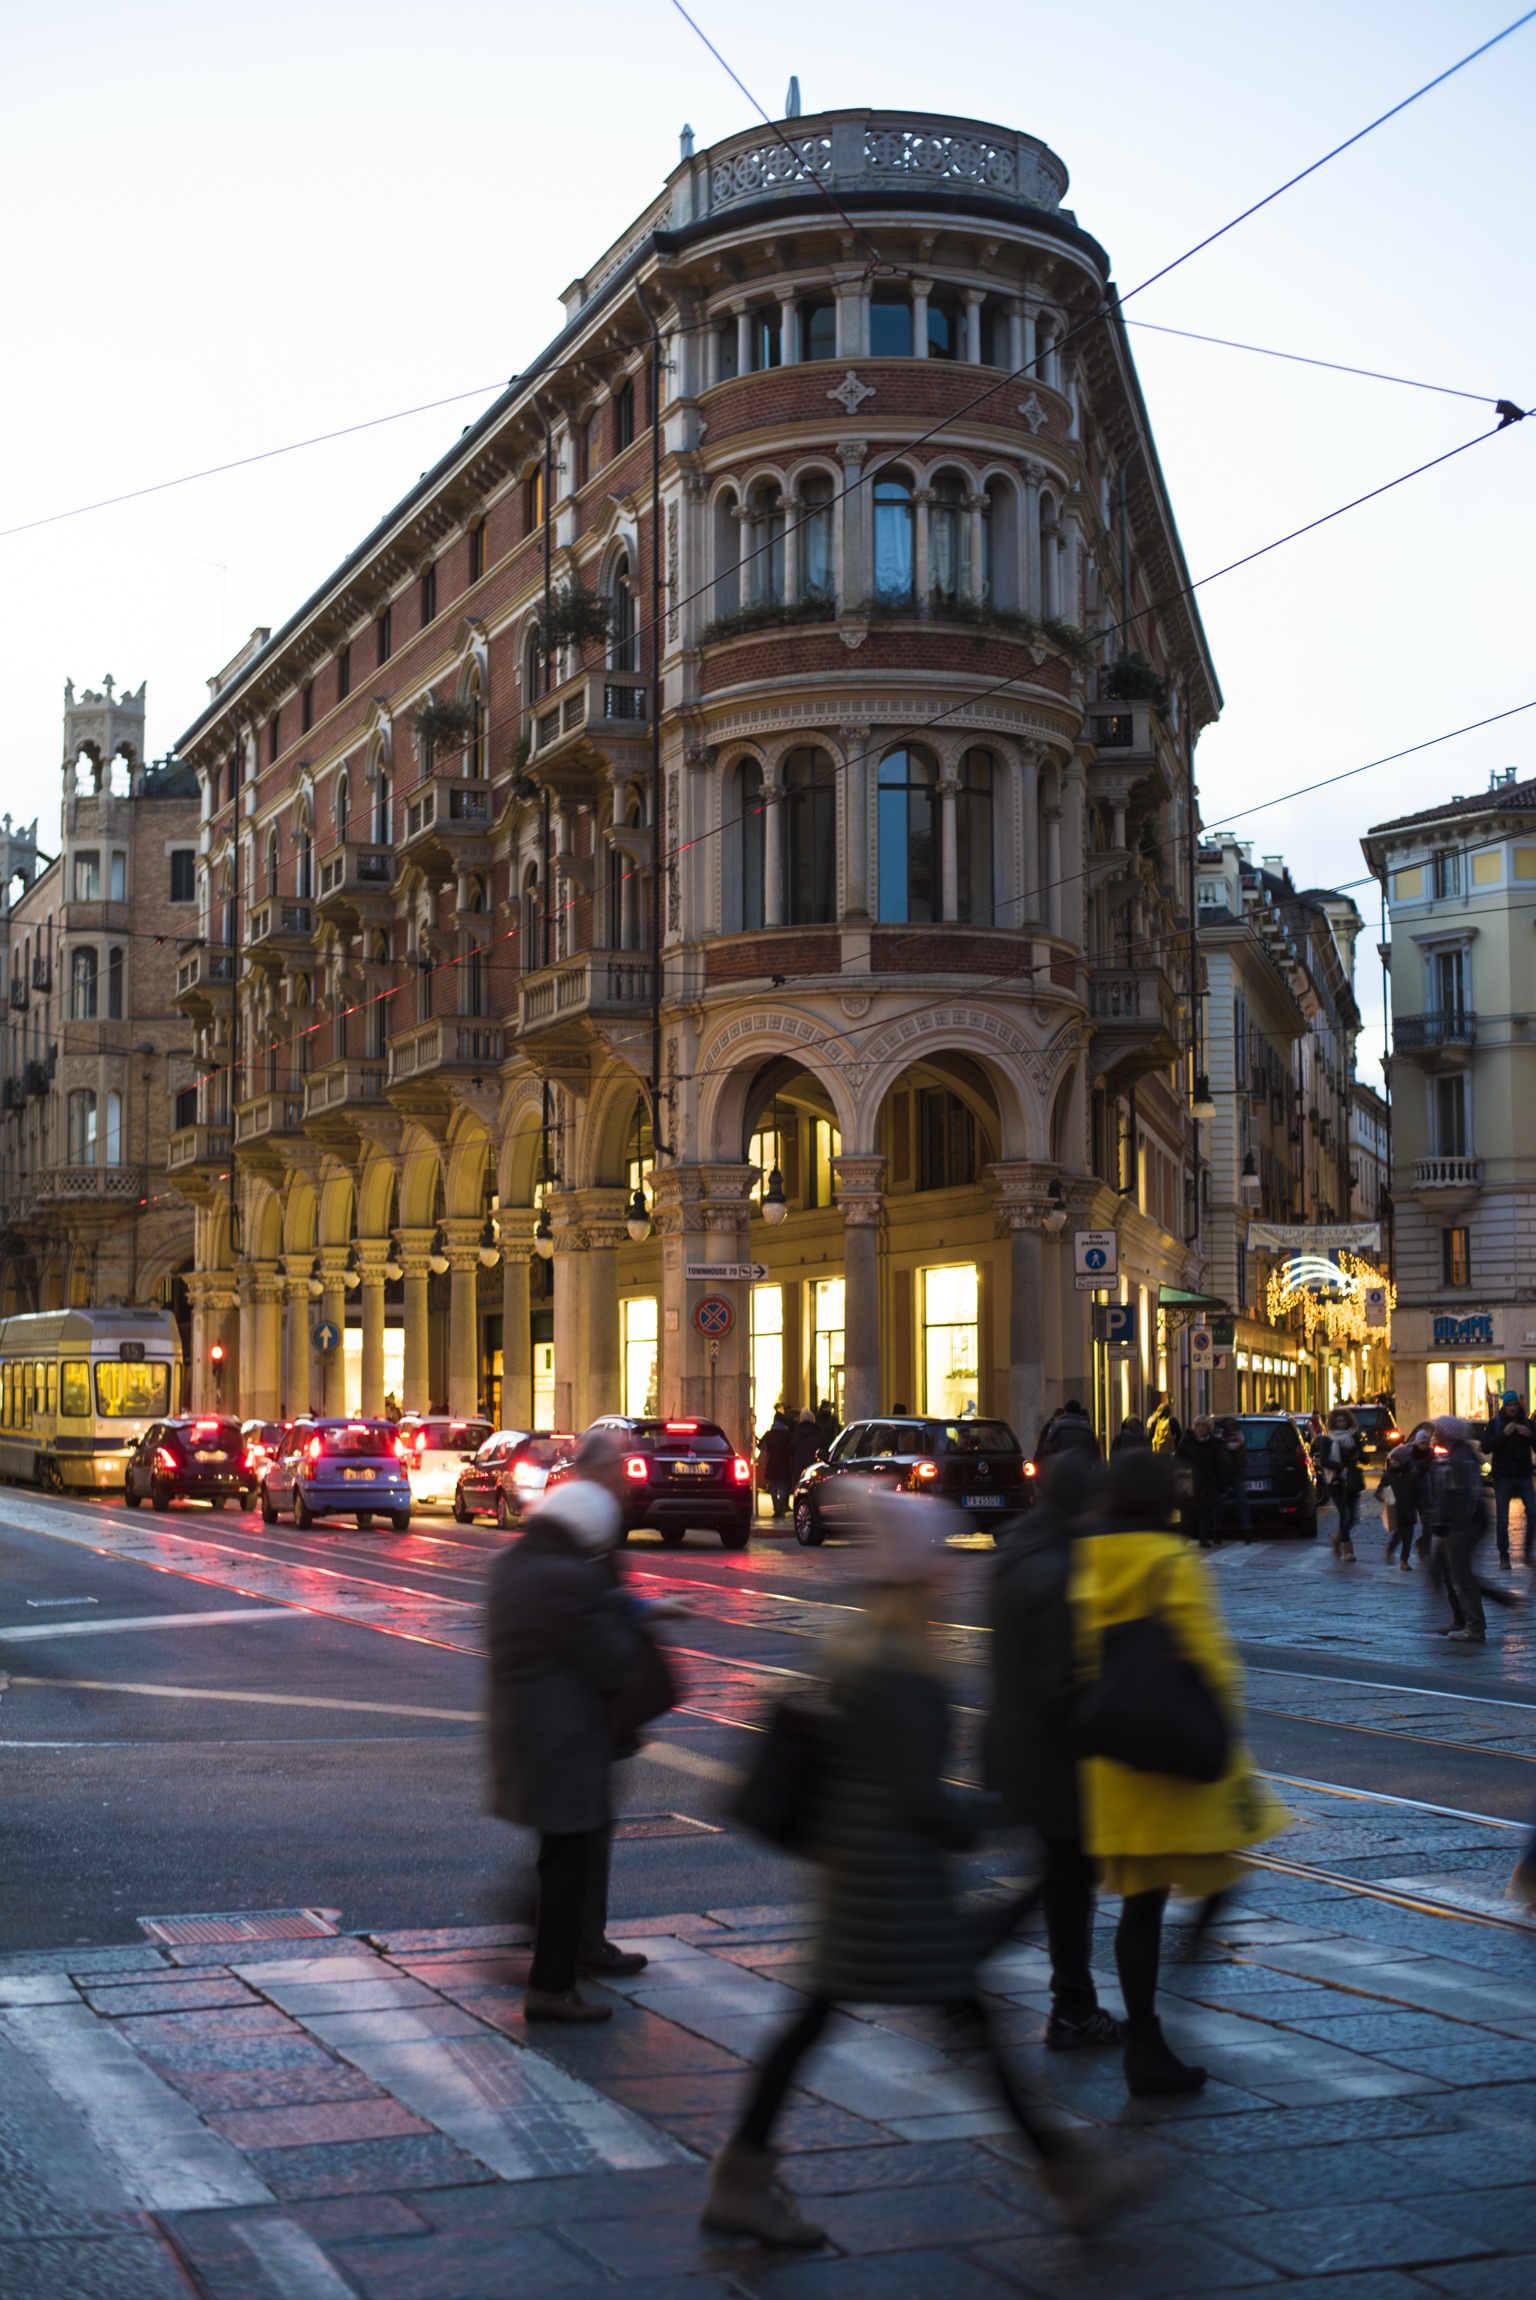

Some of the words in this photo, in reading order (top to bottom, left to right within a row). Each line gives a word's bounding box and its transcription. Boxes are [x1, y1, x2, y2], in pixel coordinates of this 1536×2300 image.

[688, 1267, 727, 1275] TOWNHOUSE
[729, 1267, 737, 1275] 70
[1105, 1309, 1127, 1339] P
[1434, 1316, 1493, 1337] GIEMME
